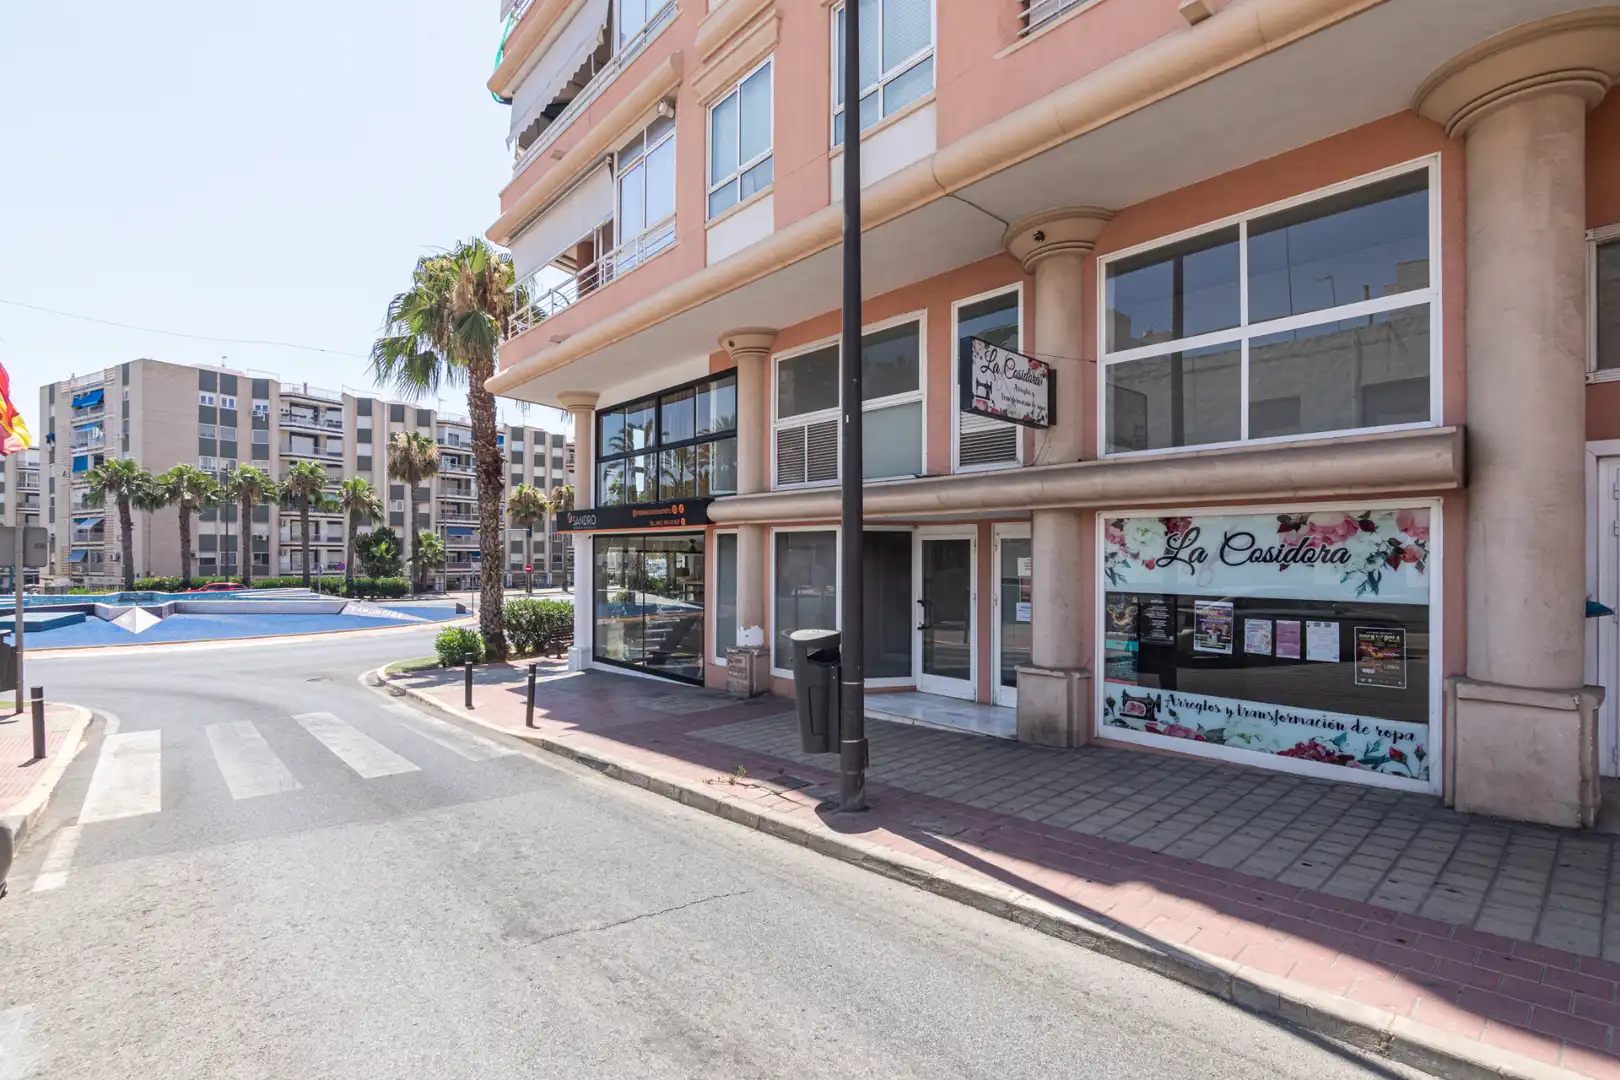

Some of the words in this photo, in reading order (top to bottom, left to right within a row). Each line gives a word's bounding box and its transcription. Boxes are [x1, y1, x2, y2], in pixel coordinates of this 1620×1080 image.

[980, 348, 1000, 381] La
[1004, 357, 1043, 386] Cosidora
[572, 514, 597, 526] SANDRO
[1156, 526, 1208, 576] La
[1220, 531, 1352, 567] Cosidora
[1164, 694, 1221, 715] Arreglos
[1226, 706, 1234, 719] y
[1351, 718, 1370, 735] de
[1375, 724, 1417, 745] ropa
